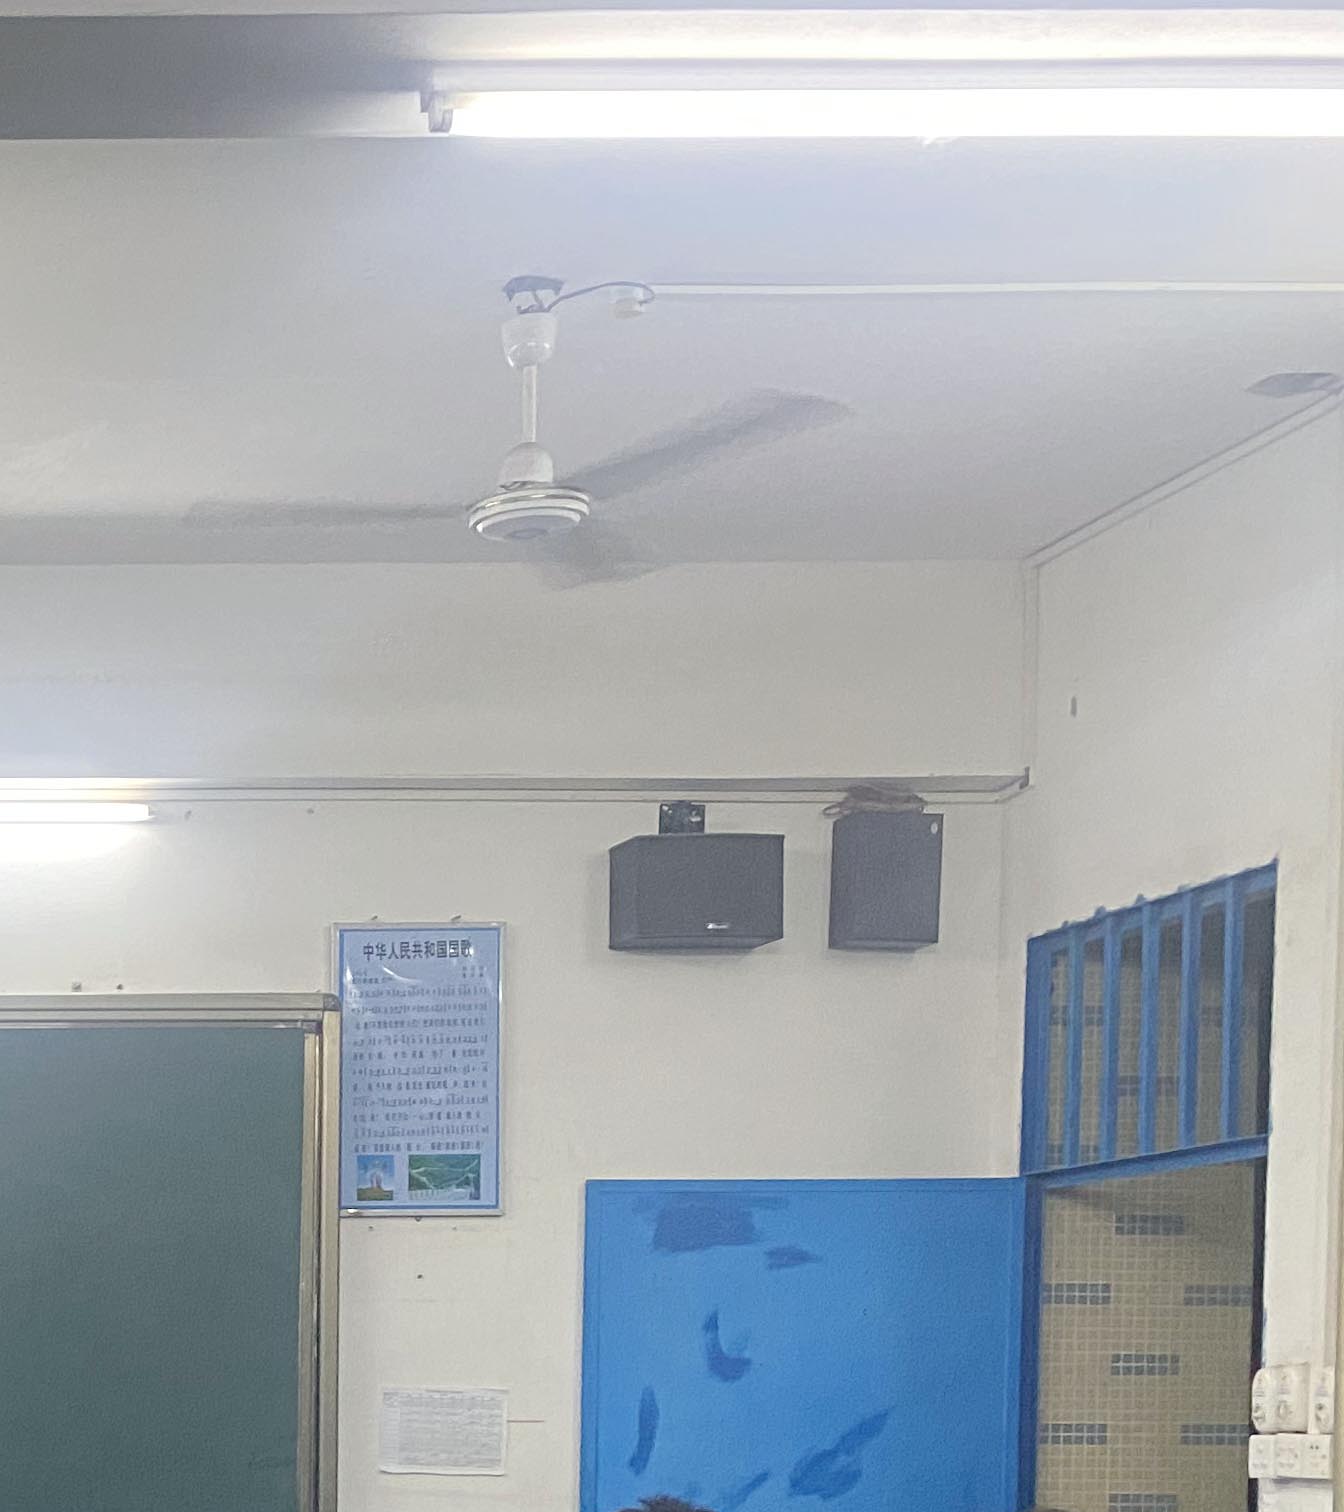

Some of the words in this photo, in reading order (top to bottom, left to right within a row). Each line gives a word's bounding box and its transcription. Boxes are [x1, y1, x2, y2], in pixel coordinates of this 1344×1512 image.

[362, 939, 472, 961] 中华人民共和国国歌
